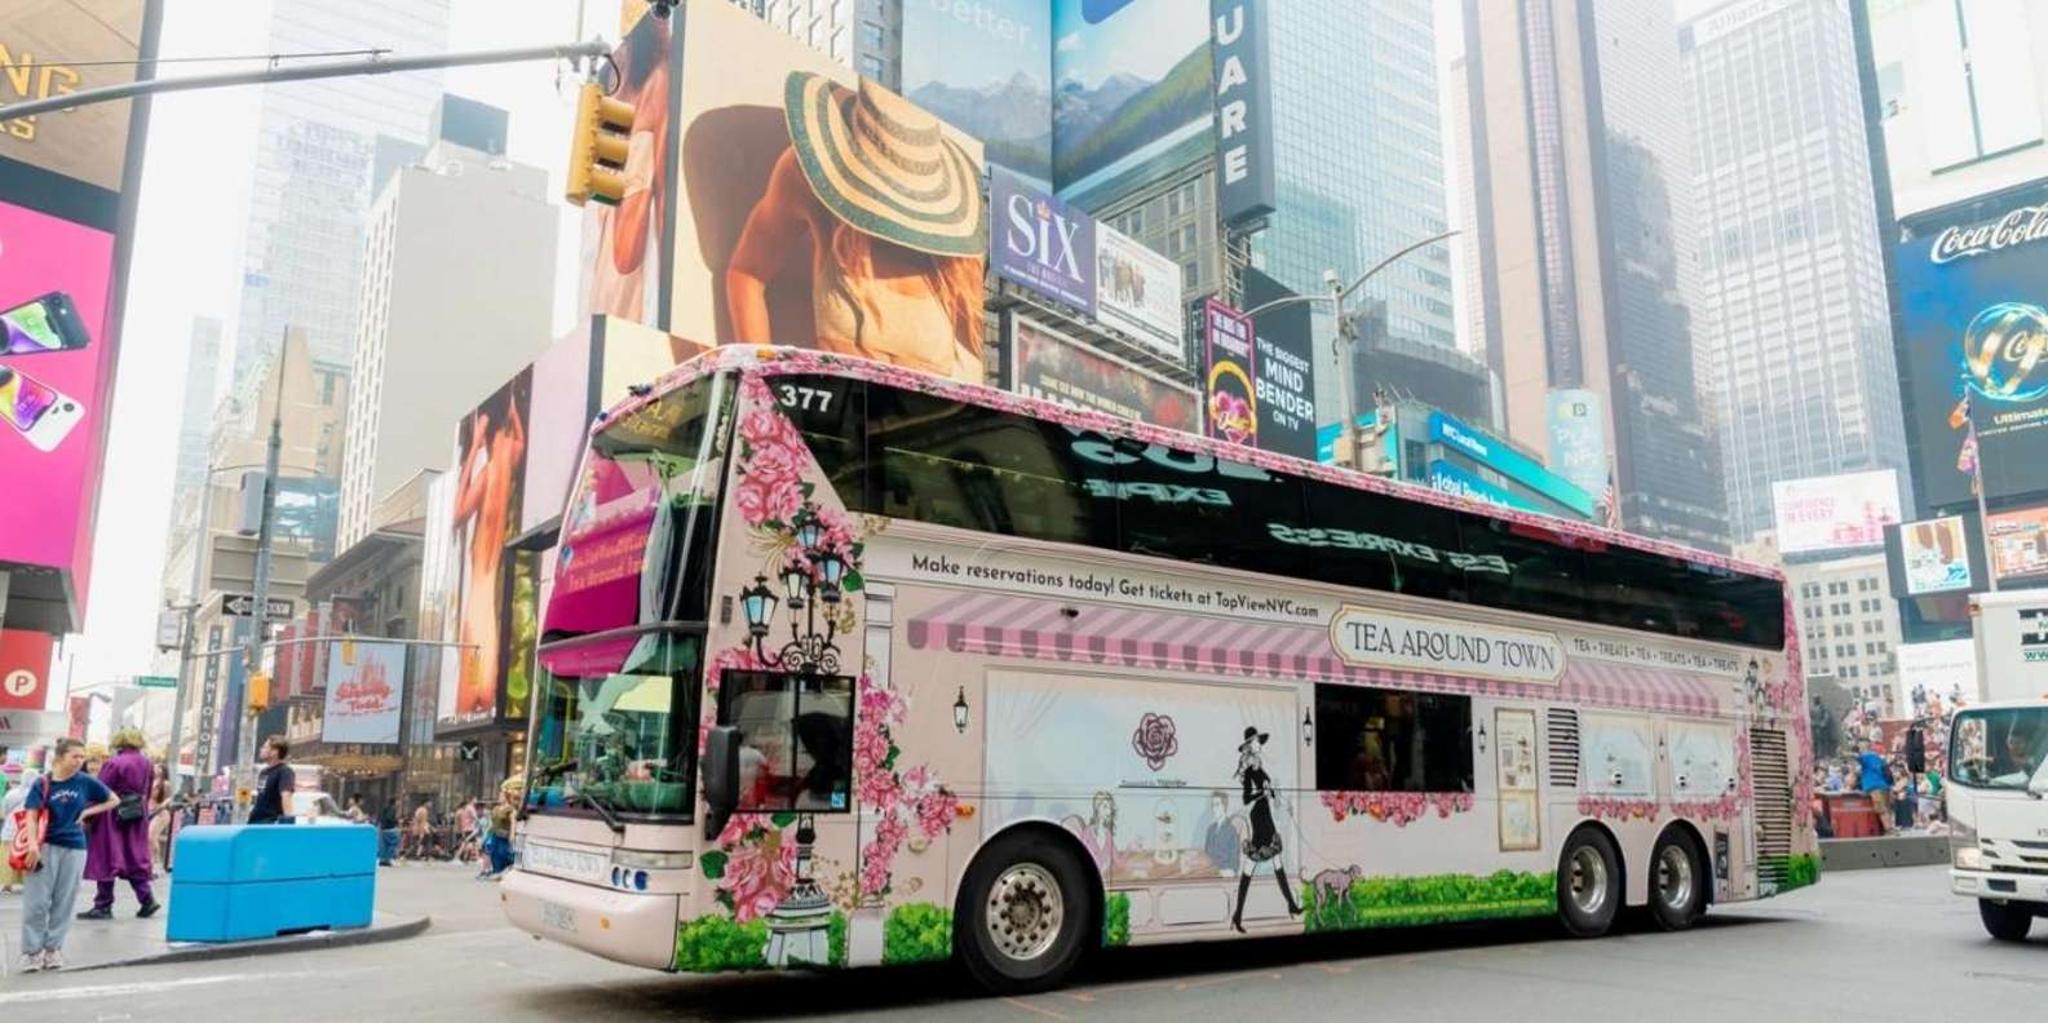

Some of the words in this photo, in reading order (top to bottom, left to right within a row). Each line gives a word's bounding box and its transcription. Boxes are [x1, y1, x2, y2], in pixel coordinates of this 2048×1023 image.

[1256, 336, 1274, 356] THE
[1275, 347, 1310, 373] BIGGEST
[1265, 358, 1304, 392] MIND
[780, 384, 833, 413] 377
[1256, 377, 1315, 422] BENDER
[1273, 410, 1287, 426] ON
[1287, 416, 1300, 431] TV
[912, 555, 960, 576] Make
[967, 565, 1064, 588] reservations
[1069, 573, 1115, 597] today!
[1119, 579, 1145, 597] Get
[1149, 585, 1193, 604] tickets
[1197, 593, 1212, 605] at
[1216, 591, 1319, 619] TopViewNYC.com
[1345, 621, 1395, 655] TEA
[1400, 628, 1490, 664] AROUND
[1495, 640, 1555, 671] TOWN
[1574, 639, 1590, 652] TEA
[1600, 643, 1628, 657] TREATS
[1637, 648, 1650, 660] TEA
[1659, 651, 1686, 665] TREATS
[1713, 658, 1738, 671] TREATS
[15, 675, 28, 691] P
